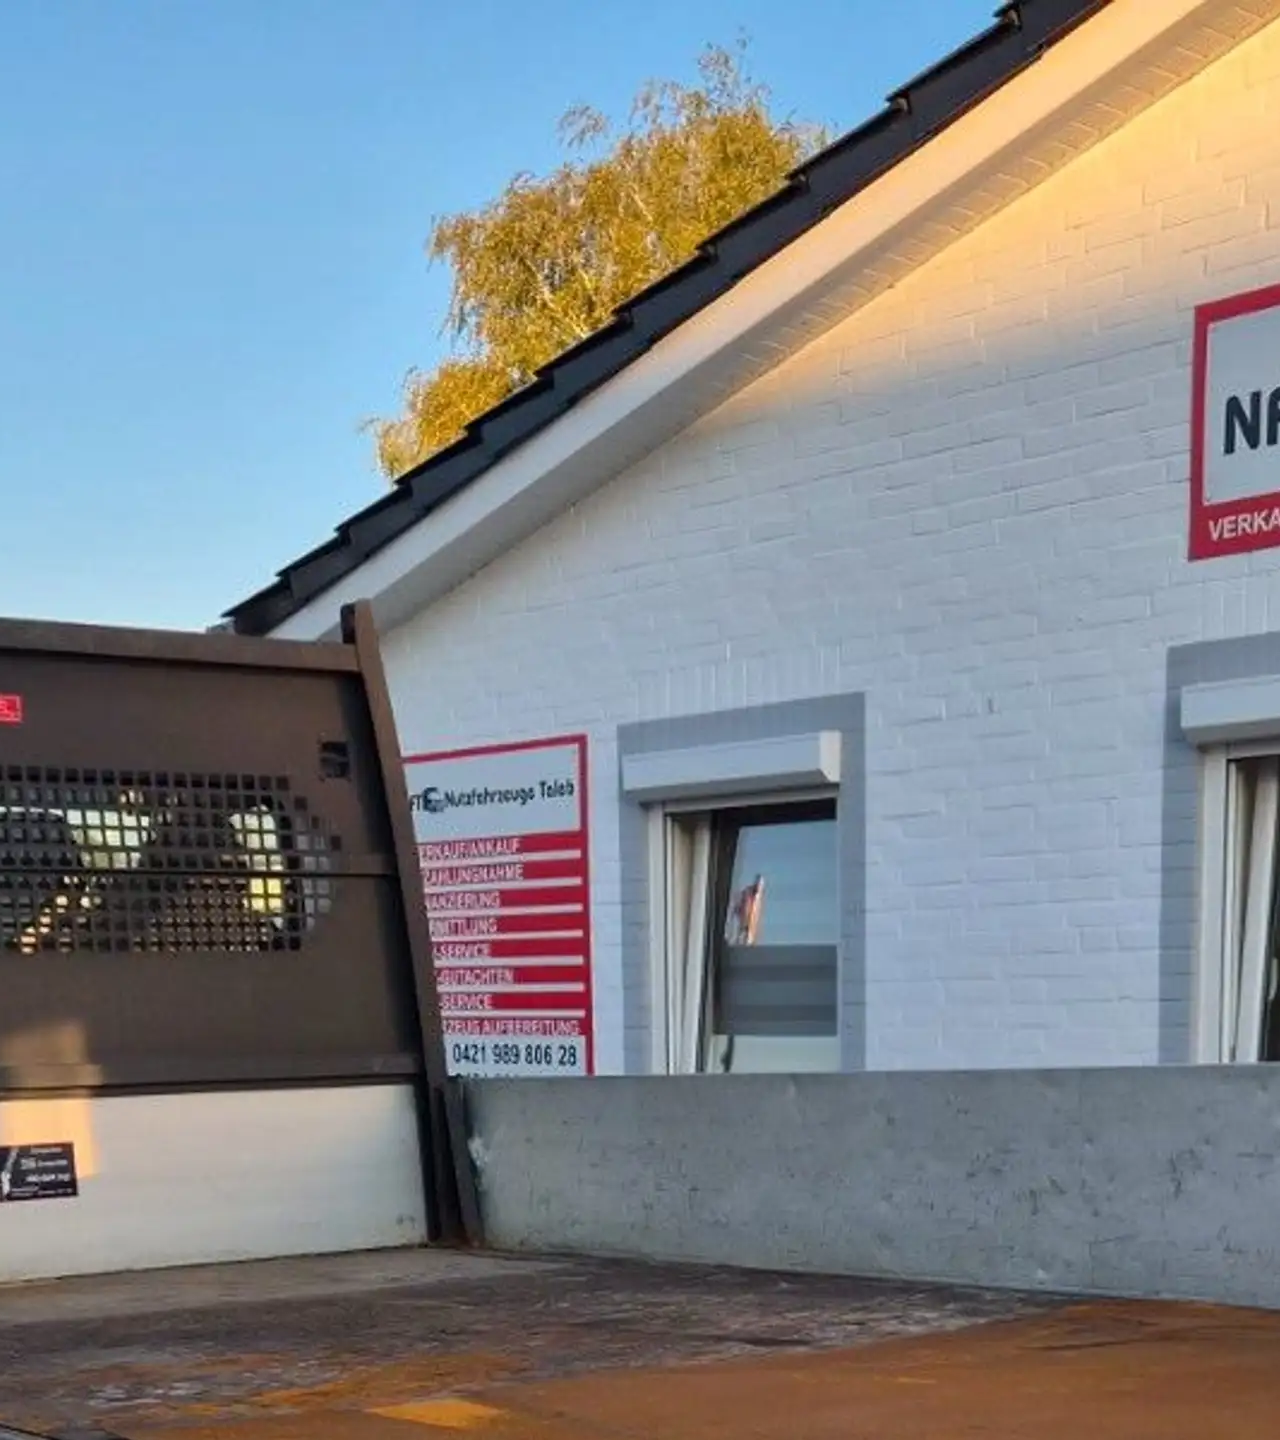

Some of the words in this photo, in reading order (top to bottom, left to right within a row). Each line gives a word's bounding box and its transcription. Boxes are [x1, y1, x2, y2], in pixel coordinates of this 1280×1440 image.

[539, 779, 575, 799] Taleb
[453, 1043, 486, 1063] 0421
[525, 1043, 552, 1065] 806
[558, 1043, 577, 1066] 28
